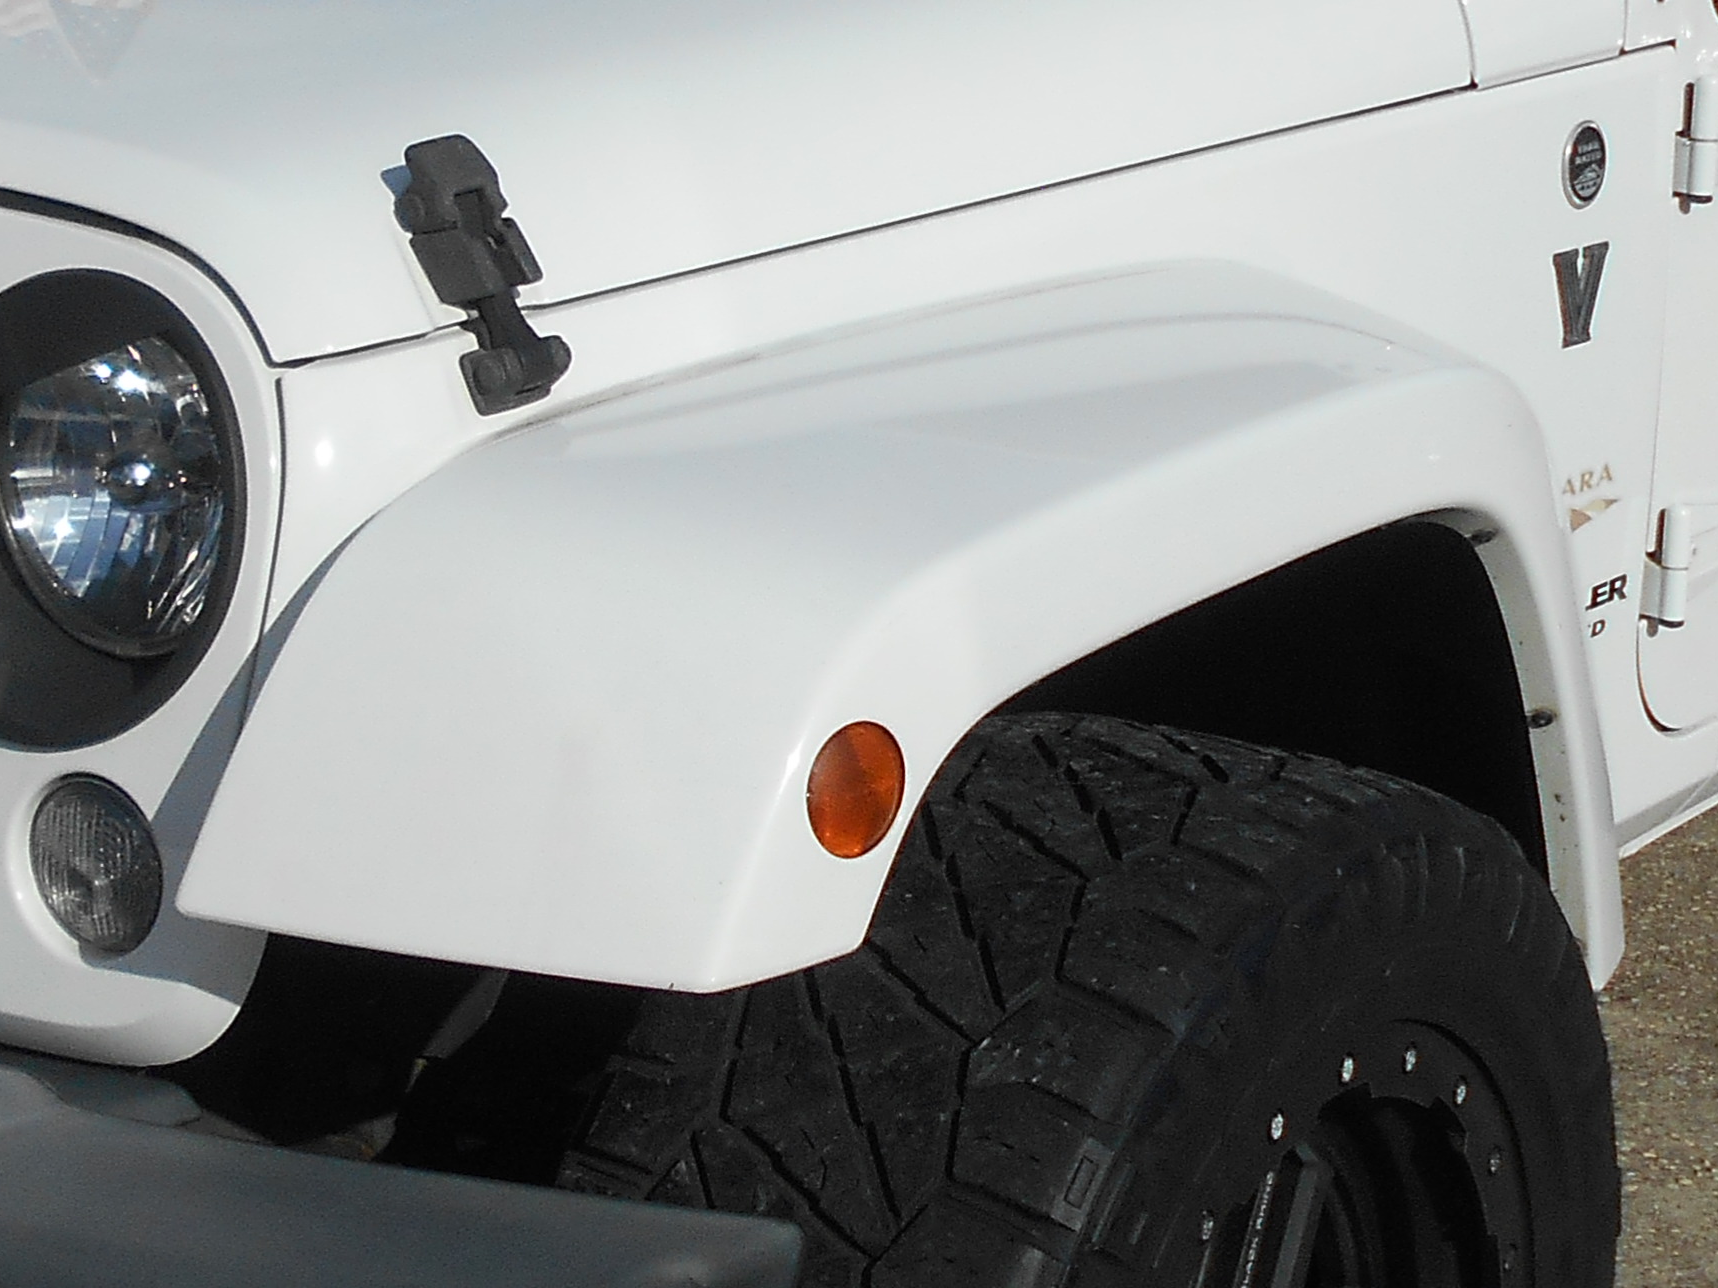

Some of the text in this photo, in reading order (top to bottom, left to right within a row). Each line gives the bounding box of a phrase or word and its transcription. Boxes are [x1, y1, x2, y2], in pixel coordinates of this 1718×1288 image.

[1553, 241, 1610, 349] V
[1562, 464, 1612, 495] ARA
[1586, 573, 1628, 611] ER
